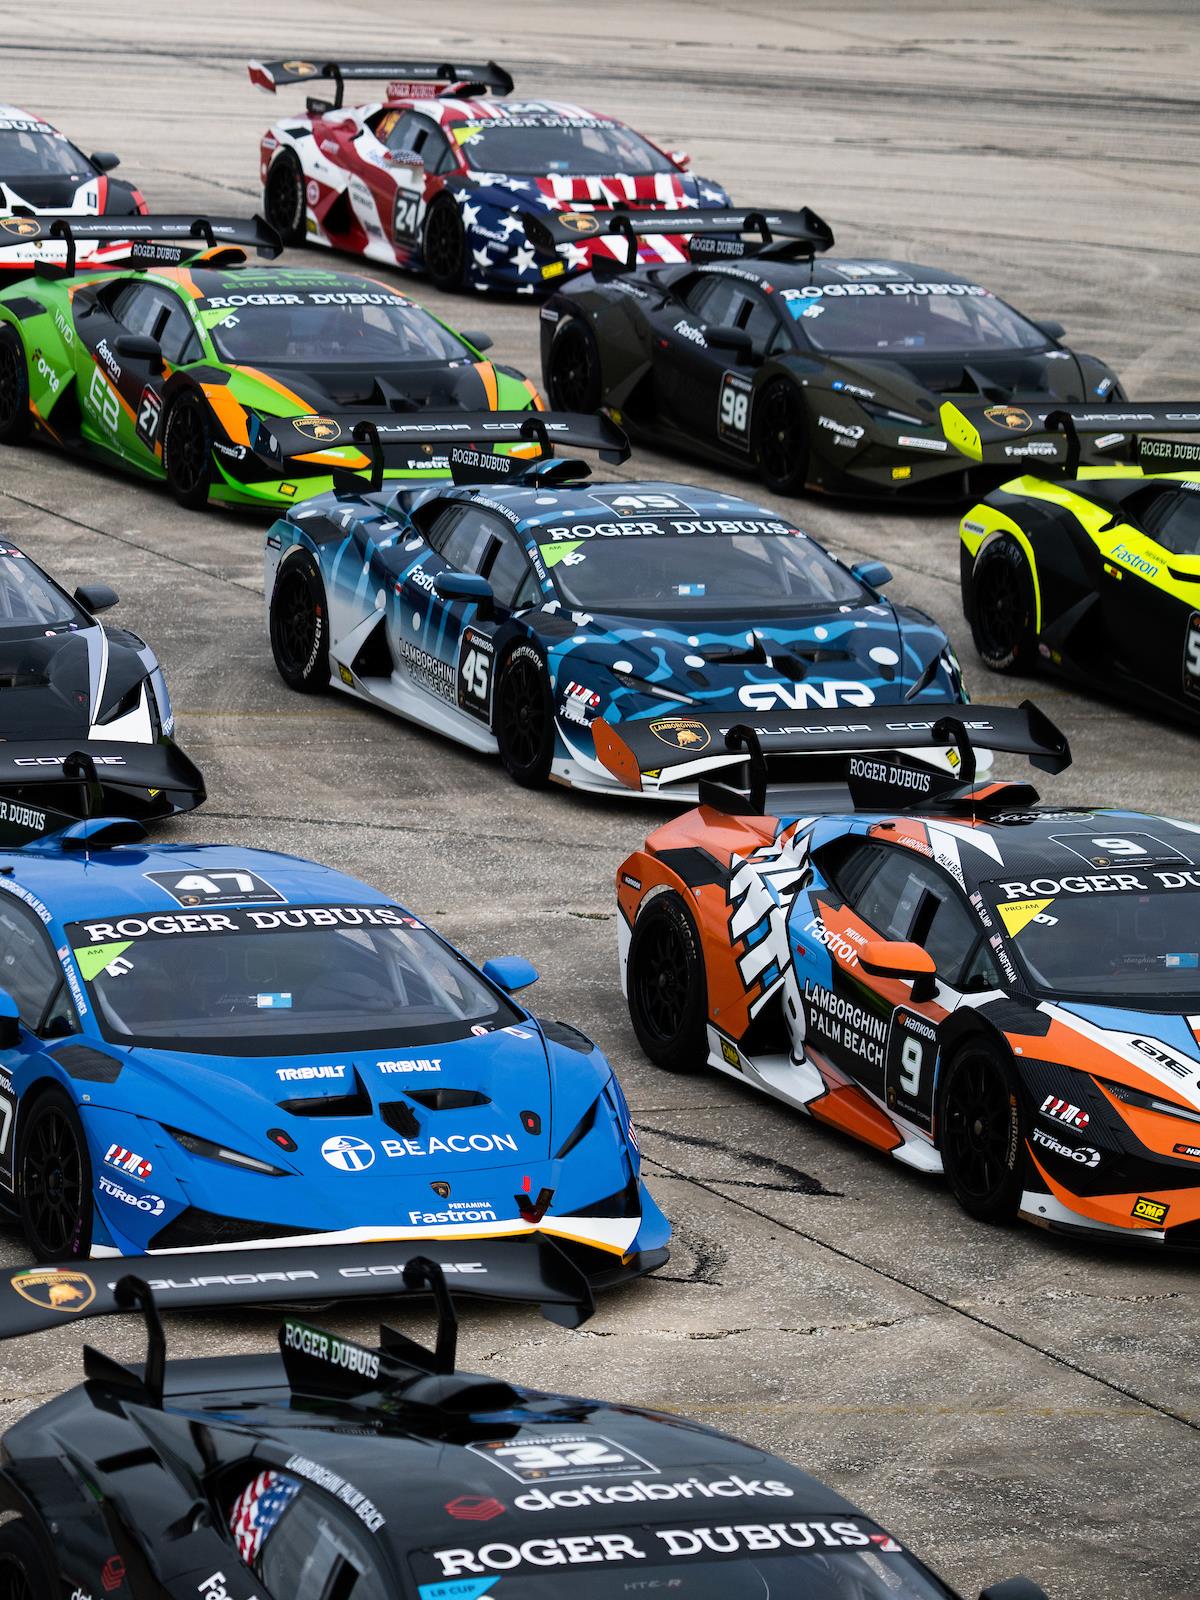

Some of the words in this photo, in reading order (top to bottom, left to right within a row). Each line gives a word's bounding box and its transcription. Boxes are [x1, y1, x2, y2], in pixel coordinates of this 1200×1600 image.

[397, 197, 417, 233] 24
[133, 244, 157, 260] ROGER
[156, 247, 181, 262] DUBUIS
[690, 237, 715, 252] ROGER
[714, 241, 745, 256] DUBUIS
[207, 294, 304, 309] ROGER
[310, 293, 407, 307] DUBUIS
[780, 284, 886, 301] ROGER
[886, 283, 987, 297] DUBUIS
[96, 338, 122, 384] Fastron
[138, 400, 159, 437] 27
[720, 387, 750, 432] 98
[452, 448, 479, 469] ROGER
[479, 452, 511, 474] DUBUIS
[1004, 446, 1058, 458] Fastron
[1141, 441, 1173, 458] ROGER
[611, 495, 682, 510] 45
[547, 523, 666, 541] ROGER
[670, 520, 792, 536] DUBUIS
[1110, 543, 1159, 578] Fastron
[400, 637, 456, 685] LAMBORGHINI
[461, 648, 490, 700] 45
[407, 662, 431, 695] PALM
[430, 676, 456, 708] BEACH
[653, 721, 701, 732] LAMBORGHINI
[849, 758, 885, 785] ROGER
[888, 765, 931, 793] DUBUIS
[8, 803, 46, 832] DUBUIS
[1091, 838, 1148, 855] 9
[897, 834, 935, 859] LAMBORGHINI
[936, 852, 953, 873] PALM
[948, 865, 968, 888] BEACH
[173, 872, 256, 894] 47
[998, 873, 1149, 900] ROGER
[32, 901, 53, 926] BEACH
[980, 908, 993, 929] SLIMP
[1004, 903, 1040, 912] PRO-AM
[84, 912, 240, 943] ROGER
[246, 908, 405, 930] DUBUIS
[87, 947, 105, 955] AM
[104, 956, 135, 978] 47
[998, 952, 1018, 985] HOFFMAN
[64, 966, 87, 1017] STARKWEATHER
[804, 979, 888, 1045] LAMBORGHINI
[809, 1006, 841, 1044] PALM
[843, 1029, 884, 1069] BEACH
[275, 1065, 347, 1082] TRIBUILT
[376, 1058, 442, 1074] TRIBUILT
[899, 1035, 924, 1097] 9
[379, 1133, 520, 1159] BEACON
[1032, 1131, 1087, 1164] TURBO
[99, 1180, 152, 1212] TURBO
[448, 1202, 493, 1210] PERTAMINA
[408, 1206, 497, 1226] Fastron
[1135, 1203, 1164, 1219] OMP
[17, 1275, 92, 1290] LAMBORGHINI
[284, 1324, 330, 1364] ROGER
[330, 1340, 380, 1381] DUBUIS
[494, 1441, 625, 1469] 32
[285, 1454, 343, 1497] LAMBORGHINI
[339, 1482, 365, 1510] PALM
[355, 1498, 387, 1534] BEACH
[513, 1475, 794, 1514] databricks
[432, 1534, 651, 1578] ROGER
[656, 1521, 871, 1557] DUBUIS
[429, 1586, 447, 1597] LB
[449, 1584, 476, 1596] CUP
